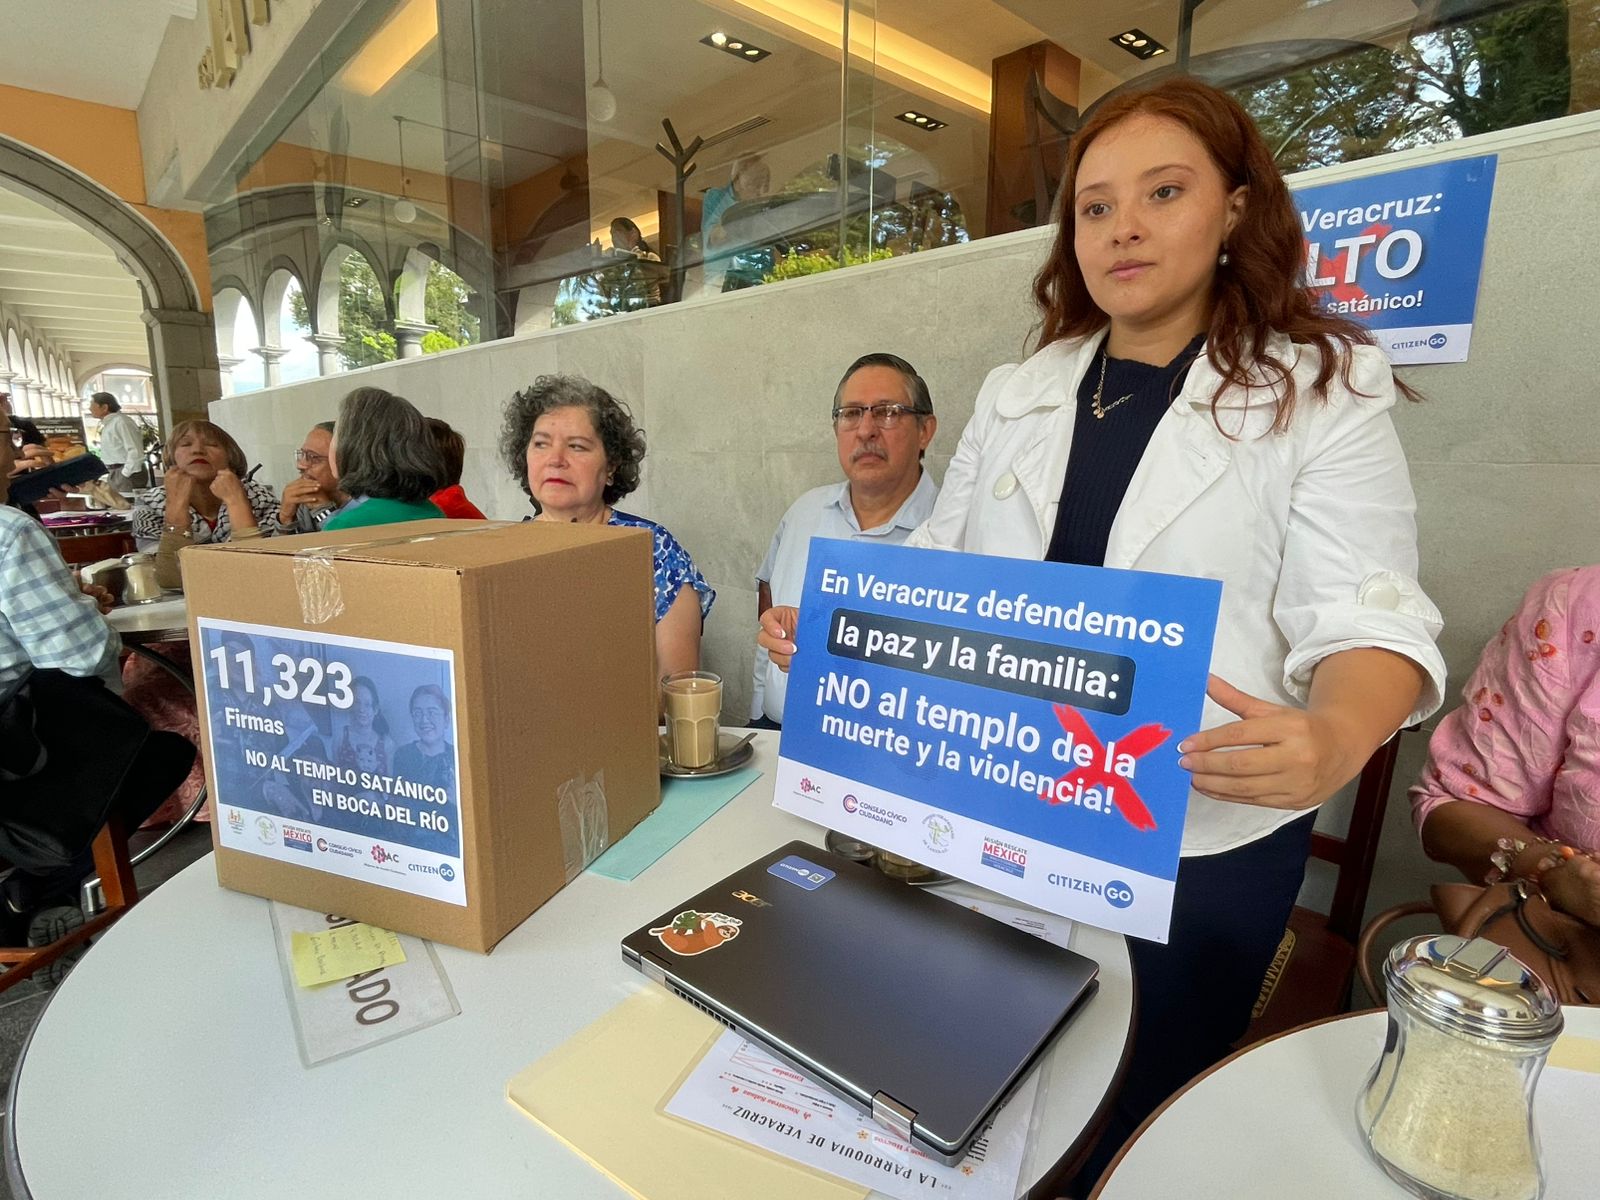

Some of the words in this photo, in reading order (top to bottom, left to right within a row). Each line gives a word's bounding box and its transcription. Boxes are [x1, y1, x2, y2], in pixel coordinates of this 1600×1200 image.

[1300, 193, 1443, 232] Veracruz:
[1305, 229, 1423, 287] LTO
[1326, 290, 1424, 314] satánico!
[820, 568, 849, 595] En
[857, 573, 970, 614] Veracruz
[976, 589, 1185, 647] defendemos
[210, 645, 354, 710] 11,323
[836, 615, 860, 648] la
[865, 628, 917, 659] paz
[922, 639, 943, 670] y
[949, 636, 977, 671] la
[986, 643, 1120, 700] familia:
[225, 706, 284, 736] Firmas
[816, 671, 871, 709] ¡NO
[878, 687, 908, 720] al
[916, 695, 1041, 753] templo
[1051, 731, 1094, 767] de
[1103, 741, 1136, 779] la
[245, 749, 267, 769] NO
[270, 753, 290, 773] AL
[293, 759, 357, 787] TEMPLO
[361, 772, 448, 805] SATÁNICO
[822, 714, 910, 756] muerte
[915, 741, 932, 767] y
[937, 740, 961, 771] la
[969, 753, 1115, 815] violencia!
[312, 788, 333, 808] EN
[337, 794, 381, 818] BOCA
[385, 804, 416, 826] DEL
[419, 810, 449, 833] RÍO
[859, 801, 887, 816] CONSEJO
[859, 809, 894, 826] CIUDADANO
[732, 1105, 802, 1139] VERACRUZ
[806, 1133, 826, 1148] DE
[919, 1172, 937, 1189] LA
